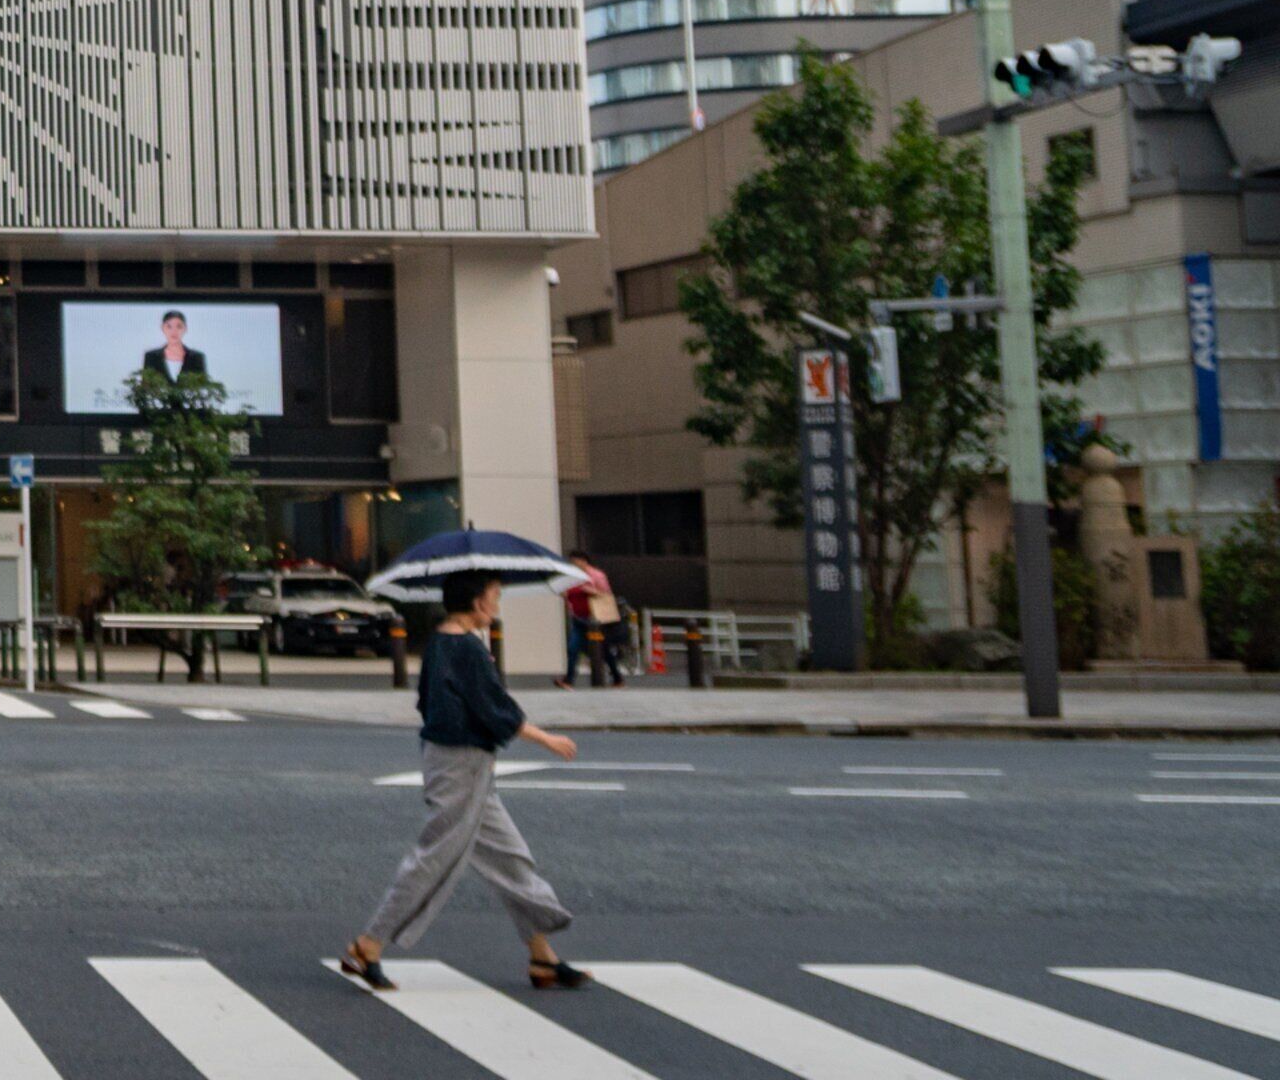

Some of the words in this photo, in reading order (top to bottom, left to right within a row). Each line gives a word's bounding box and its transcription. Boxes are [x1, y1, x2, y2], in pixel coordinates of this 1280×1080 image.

[1187, 283, 1217, 372] AOKI
[808, 429, 843, 592] 警察博物館
